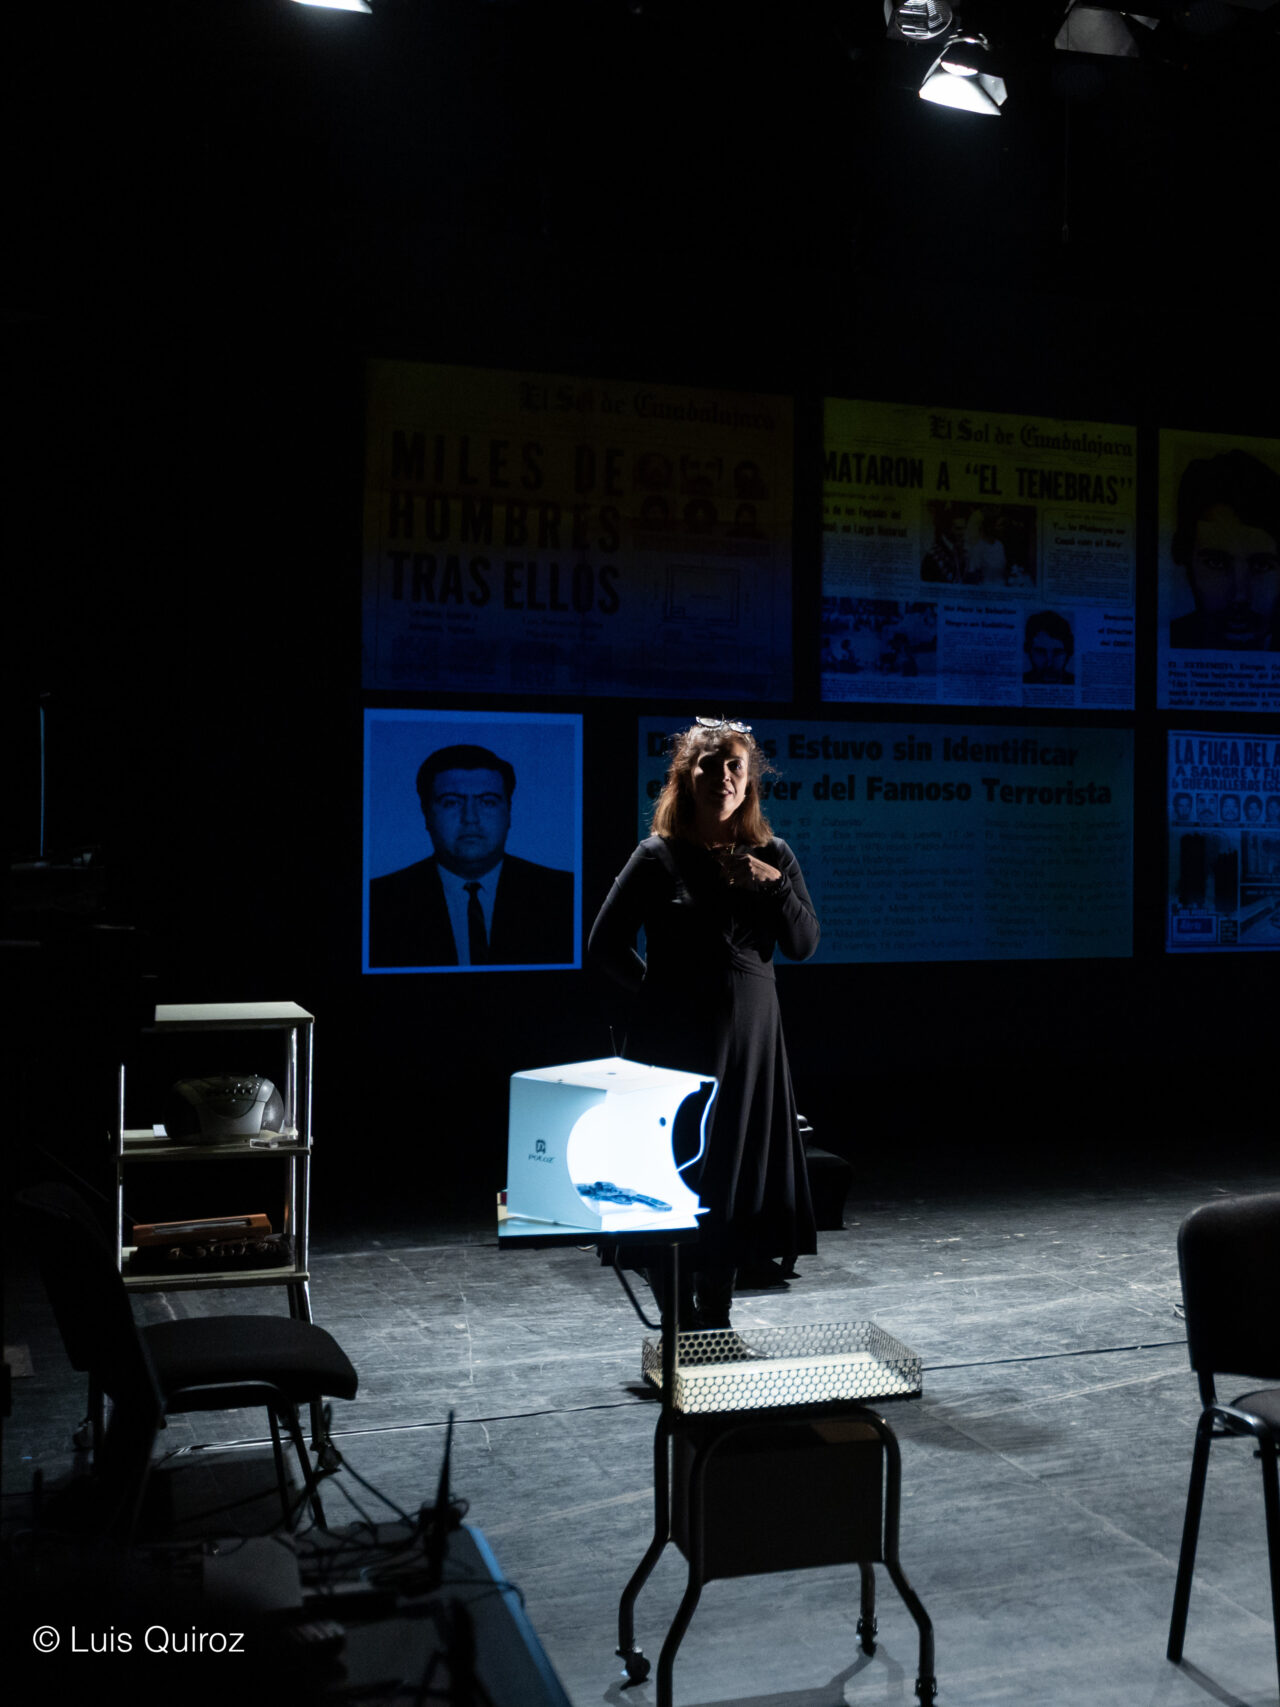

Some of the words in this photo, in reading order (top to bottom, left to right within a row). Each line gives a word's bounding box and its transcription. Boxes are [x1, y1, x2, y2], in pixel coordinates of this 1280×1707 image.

[929, 414, 950, 441] El
[957, 418, 989, 442] Sol
[995, 425, 1014, 445] de
[1020, 423, 1133, 458] Guadalajara
[392, 431, 545, 491] MILES
[575, 445, 624, 498] DE
[822, 450, 923, 489] MATARON
[936, 461, 951, 491] A
[388, 489, 620, 554] HOMBRES
[387, 549, 491, 607] TRAS
[504, 560, 620, 614] ELLOS
[789, 735, 883, 761] Estuvo
[894, 735, 932, 761] sin
[944, 736, 1078, 766] Identificar
[1175, 739, 1194, 765] LA
[1198, 740, 1240, 766] FUGA
[1244, 742, 1270, 768] DEL
[813, 774, 855, 800] del
[866, 776, 971, 802] Famoso
[982, 777, 1112, 806] Terrorista
[1191, 766, 1249, 780] SANGRE
